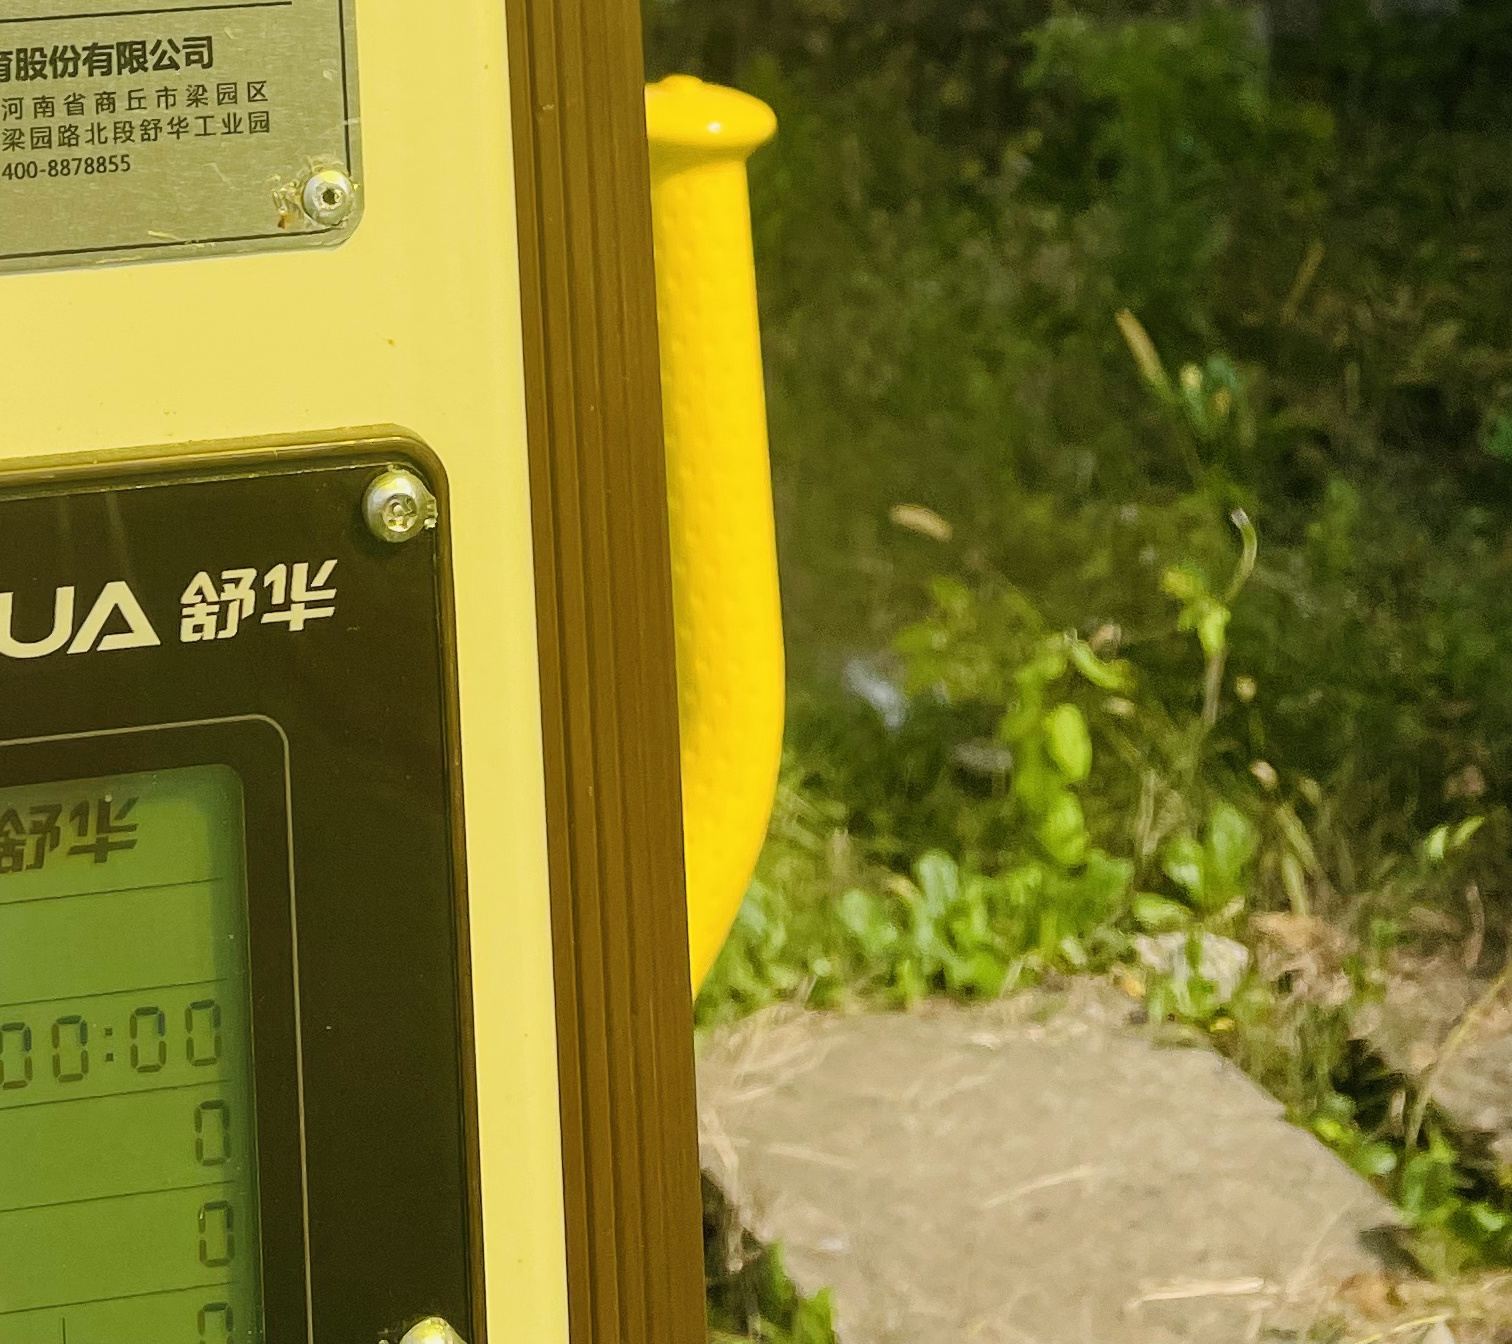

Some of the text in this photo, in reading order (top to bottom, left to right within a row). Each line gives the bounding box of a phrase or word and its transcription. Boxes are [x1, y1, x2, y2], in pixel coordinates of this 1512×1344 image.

[2, 111, 271, 152] 梁园路北段舒华工业园
[179, 559, 338, 642] 舒华
[194, 1099, 231, 1166] 0
[197, 1200, 234, 1267] 0
